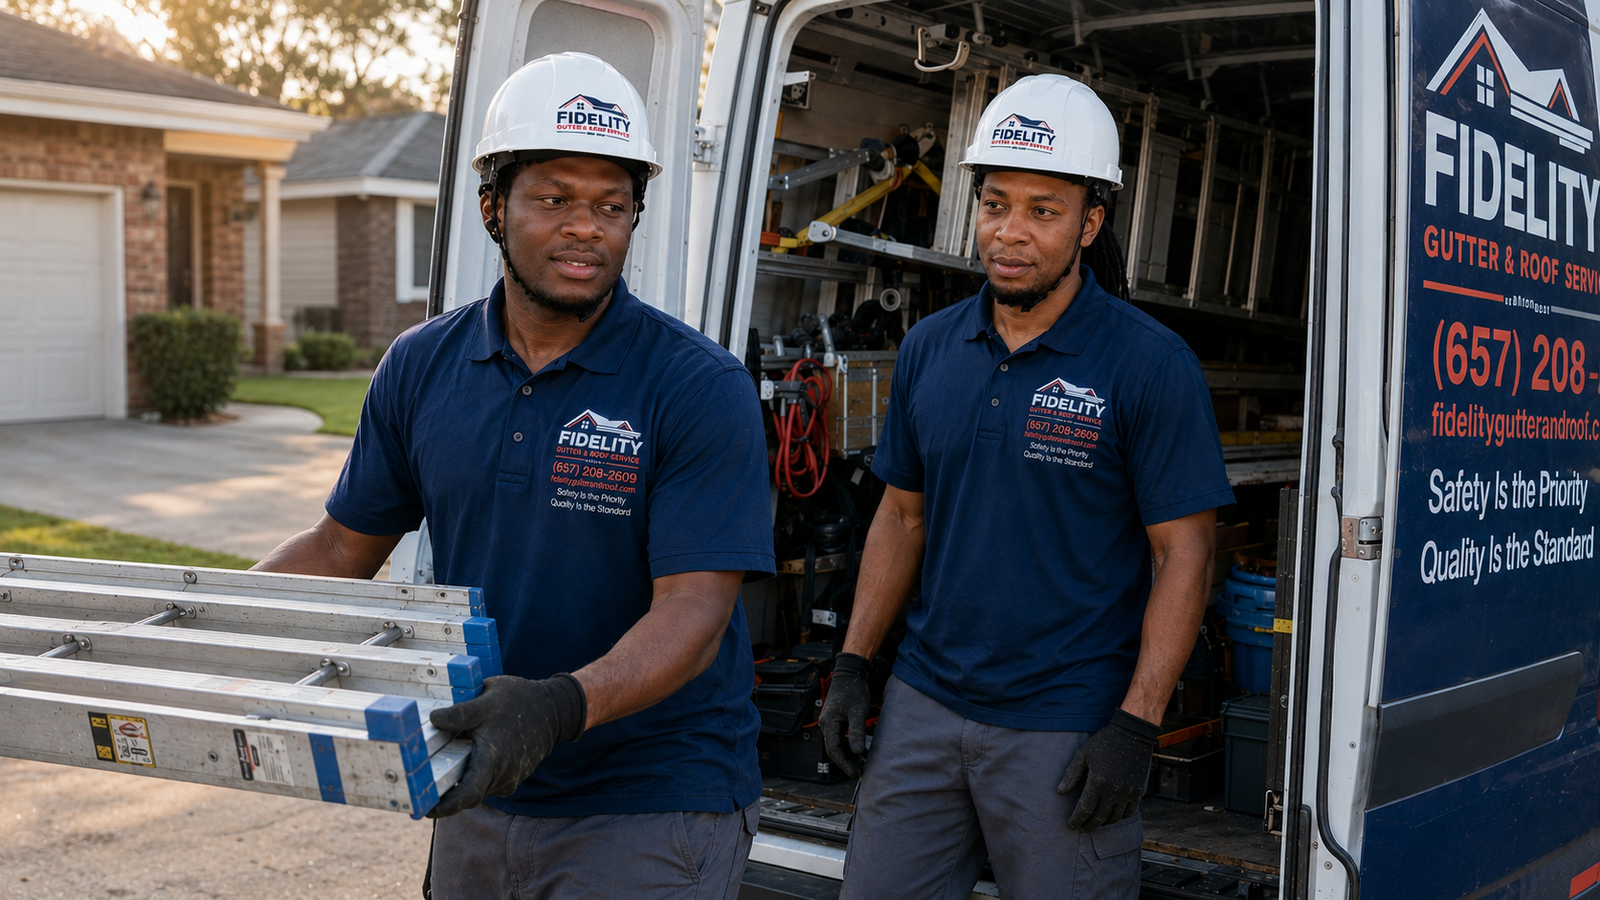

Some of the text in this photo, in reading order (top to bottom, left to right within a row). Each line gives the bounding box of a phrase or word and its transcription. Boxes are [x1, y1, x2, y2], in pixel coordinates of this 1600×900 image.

[557, 111, 630, 132] FIDELITY
[992, 129, 1056, 146] FIDELITY
[1425, 110, 1600, 252] FIDELITY
[1424, 225, 1600, 295] GUTTER & ROOF SERVI
[1433, 319, 1600, 397] (657) 208-
[1032, 393, 1106, 418] FIDELITY
[1026, 419, 1050, 433] (657)
[1052, 424, 1099, 441] 208-2609
[1432, 402, 1599, 447] fidelitygutterandroof.c
[558, 430, 643, 455] FIDELITY
[552, 461, 637, 483] (657) 208-2609
[601, 494, 626, 506] Priority
[1428, 468, 1589, 521] Safety Is the Priority
[583, 503, 596, 512] the
[597, 505, 631, 516] Standard
[1420, 526, 1595, 585] Quality Is the Standard
